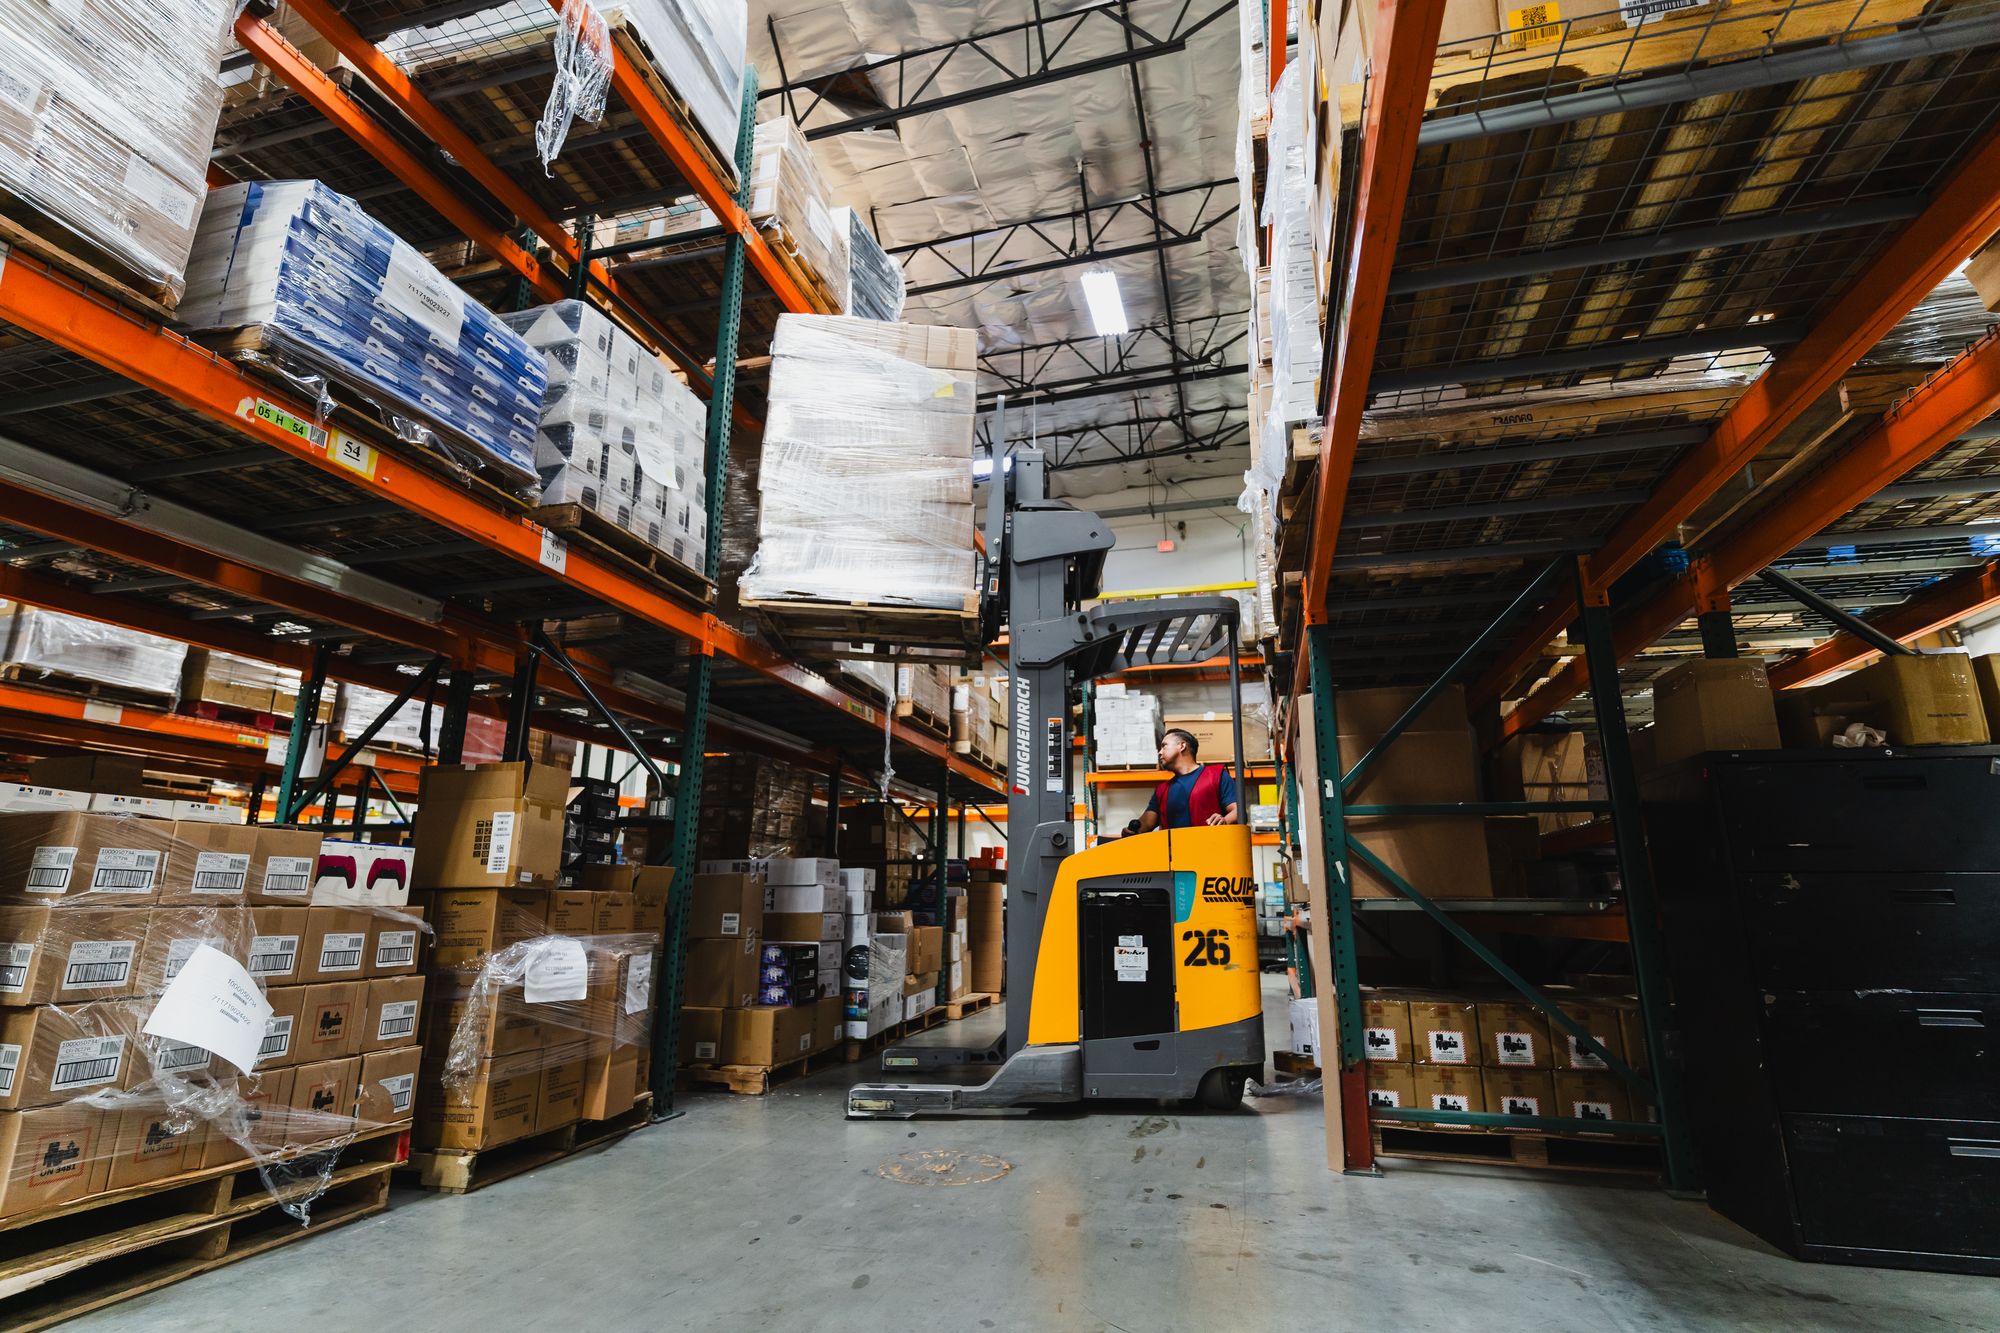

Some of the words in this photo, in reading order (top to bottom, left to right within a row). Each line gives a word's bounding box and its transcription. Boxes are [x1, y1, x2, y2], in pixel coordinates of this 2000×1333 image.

[258, 405, 271, 419] 05
[275, 414, 284, 426] H
[292, 422, 304, 436] 54
[344, 440, 361, 458] 54
[545, 550, 561, 563] STP
[1012, 676, 1030, 797] JUNGHEINRICH
[1182, 929, 1231, 967] 26
[39, 1169, 54, 1177] UN
[56, 1164, 76, 1174] 3481
